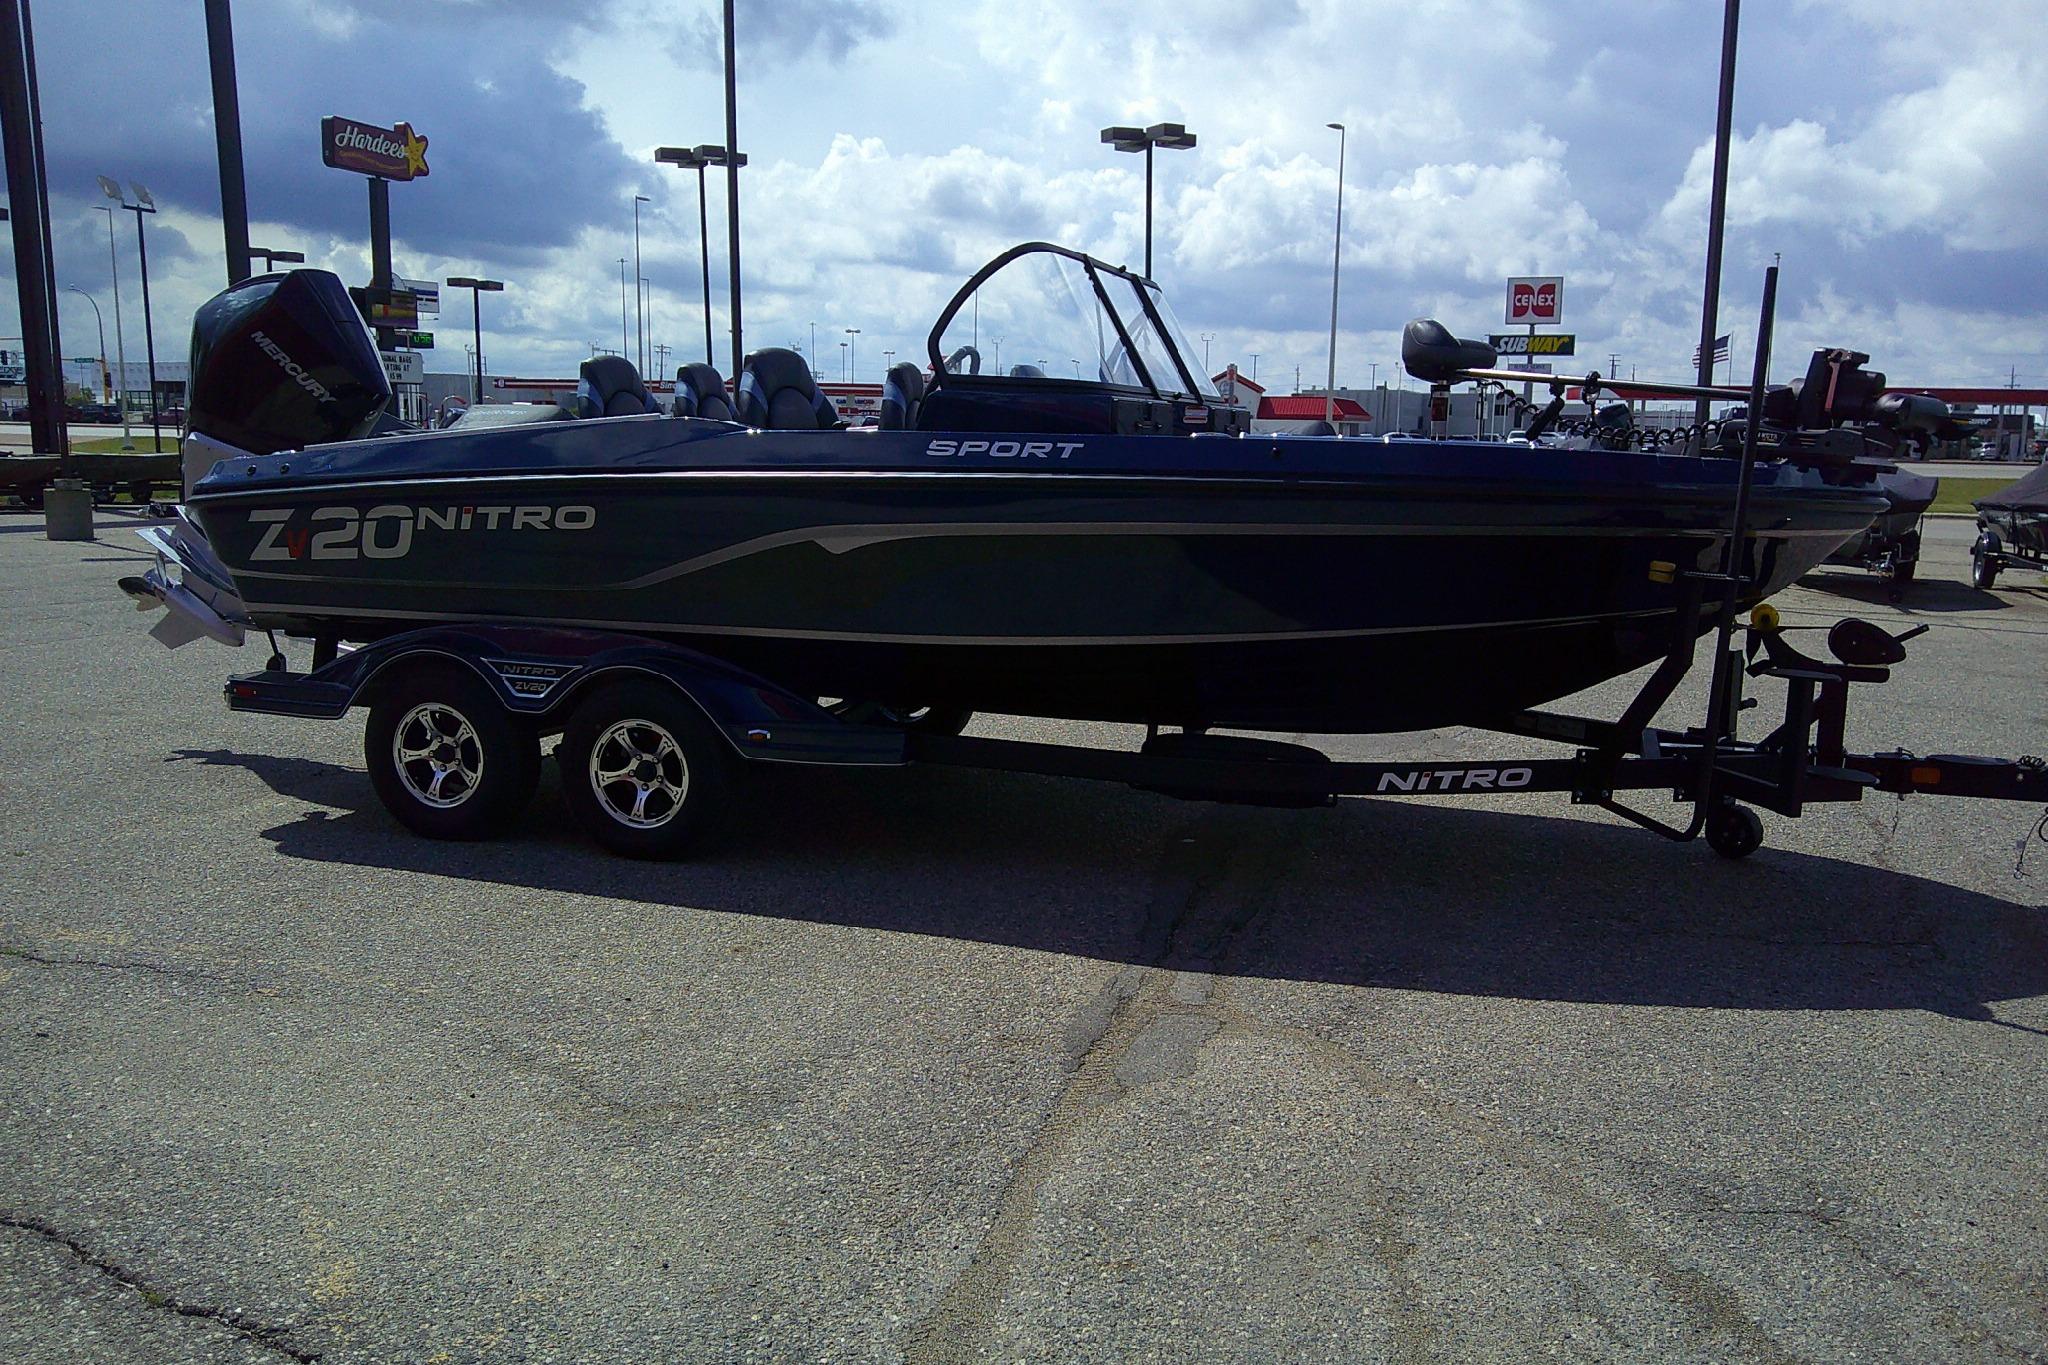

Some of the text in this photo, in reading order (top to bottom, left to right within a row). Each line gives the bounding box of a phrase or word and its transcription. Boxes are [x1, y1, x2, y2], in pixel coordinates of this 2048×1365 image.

[335, 125, 405, 159] Hardee's
[1514, 294, 1555, 307] CENEX
[1496, 336, 1569, 353] SUBWAY
[251, 330, 336, 402] MERCURY
[926, 440, 1085, 459] SPORT
[503, 664, 557, 676] NITRO
[515, 681, 546, 692] ZV20
